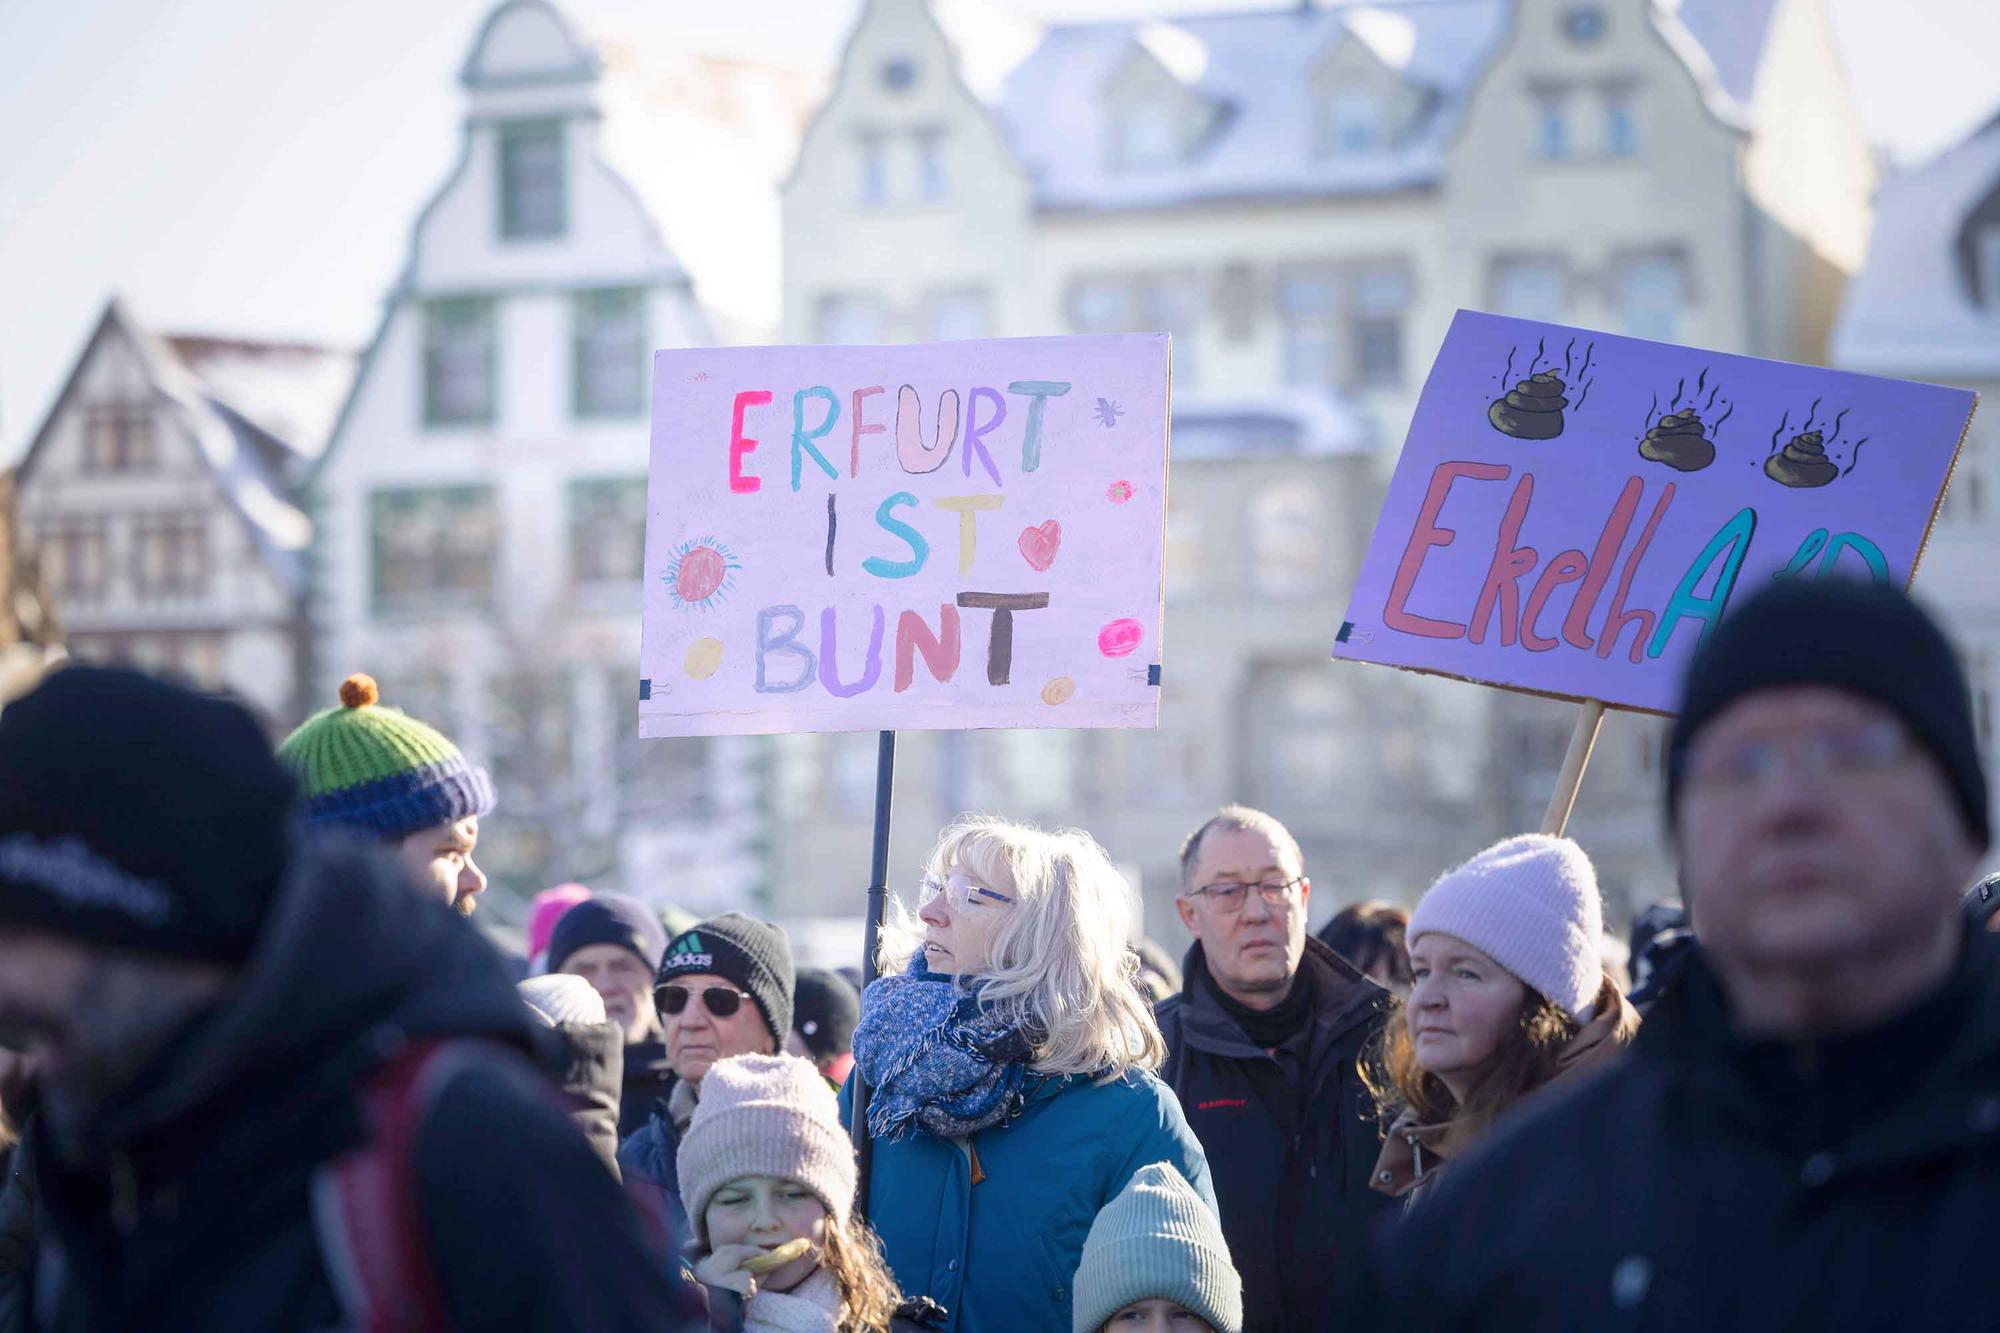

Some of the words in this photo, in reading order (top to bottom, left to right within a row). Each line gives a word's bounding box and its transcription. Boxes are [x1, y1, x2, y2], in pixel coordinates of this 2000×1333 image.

[730, 380, 1072, 493] ERFURT
[824, 491, 1005, 579] IST
[754, 591, 1050, 698] BUNT
